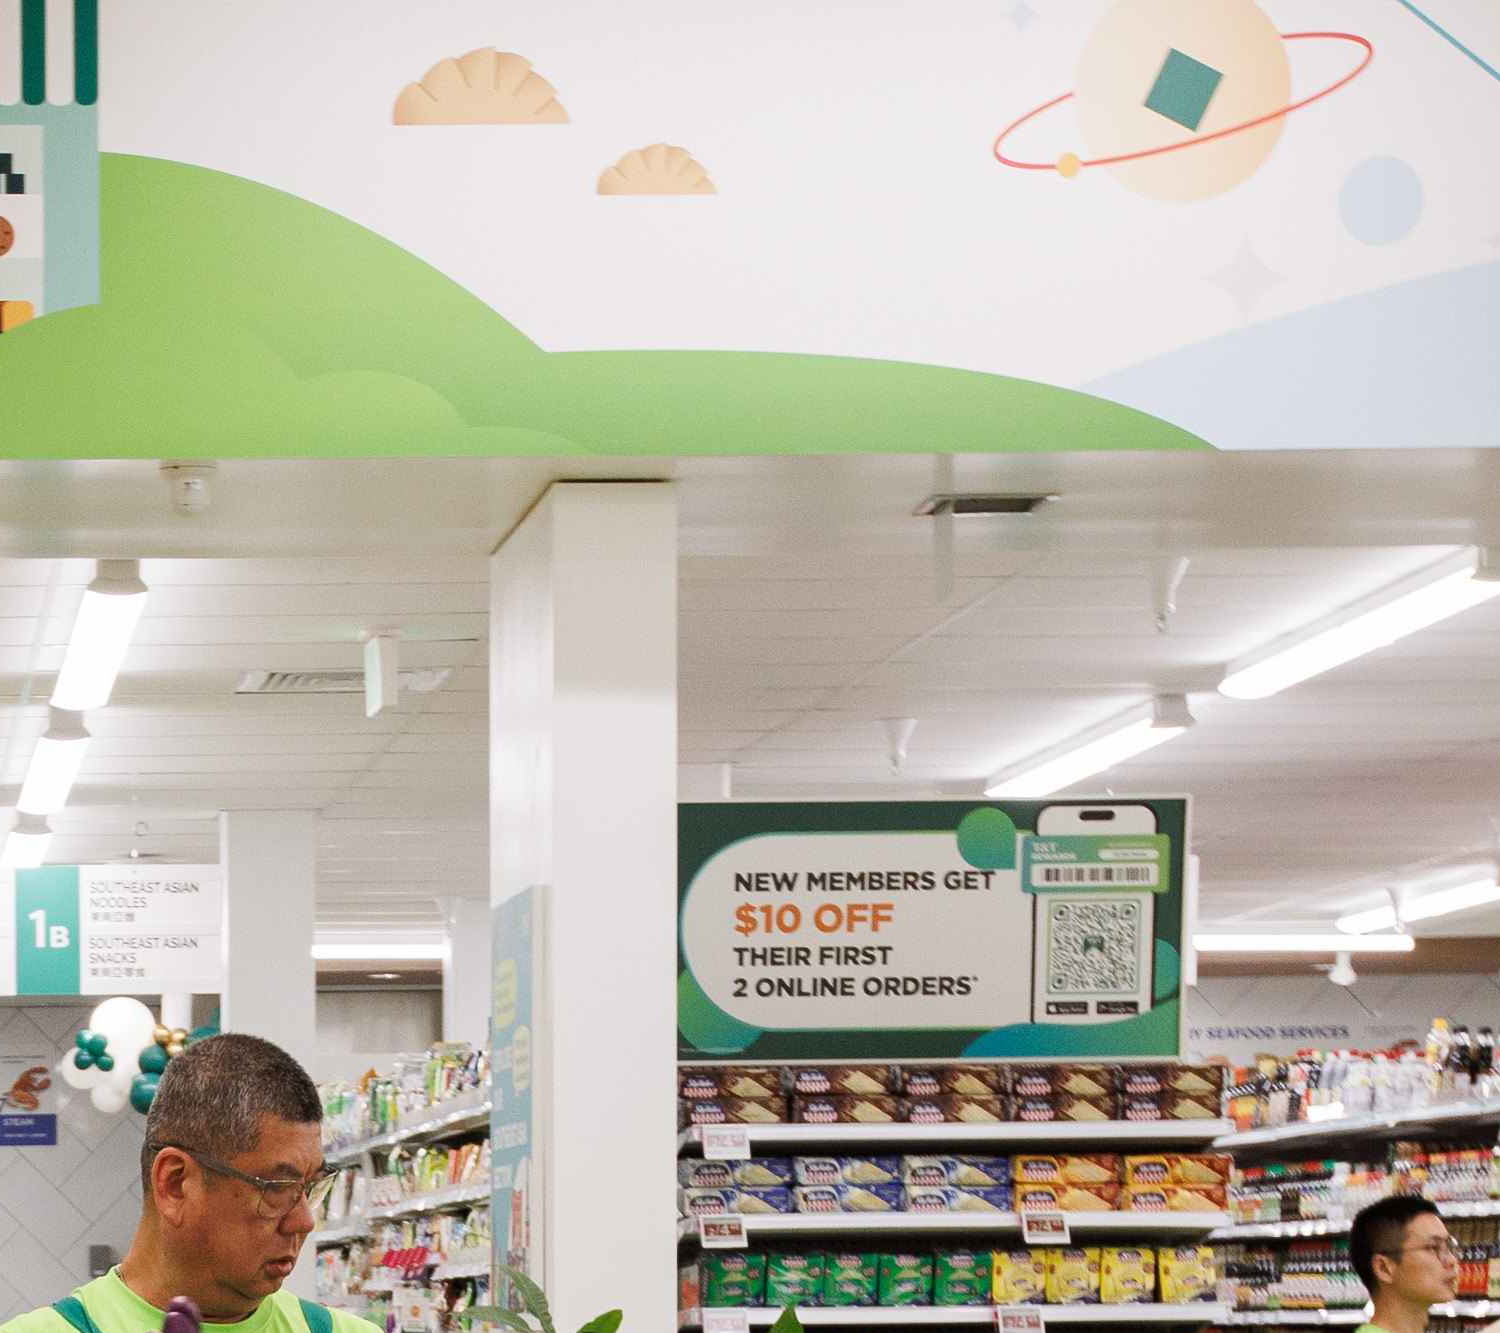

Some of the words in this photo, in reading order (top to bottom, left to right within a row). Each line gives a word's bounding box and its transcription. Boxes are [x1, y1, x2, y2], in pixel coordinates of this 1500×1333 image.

[90, 882, 161, 895] SOUTHEAST
[164, 882, 200, 893] ASIAN
[734, 871, 798, 893] NEW
[807, 871, 937, 892] MEMBERS
[944, 870, 996, 891] GET
[90, 897, 147, 909] NOODLES
[734, 903, 802, 937] $10
[813, 902, 894, 934] OFF
[89, 937, 160, 949] SOUTHEAST
[163, 936, 199, 949] ASIAN
[89, 952, 137, 964] SNACKS
[733, 946, 811, 967] THEIR
[819, 945, 894, 966] FIRST
[733, 979, 748, 998] 2
[755, 977, 855, 998] ONLINE
